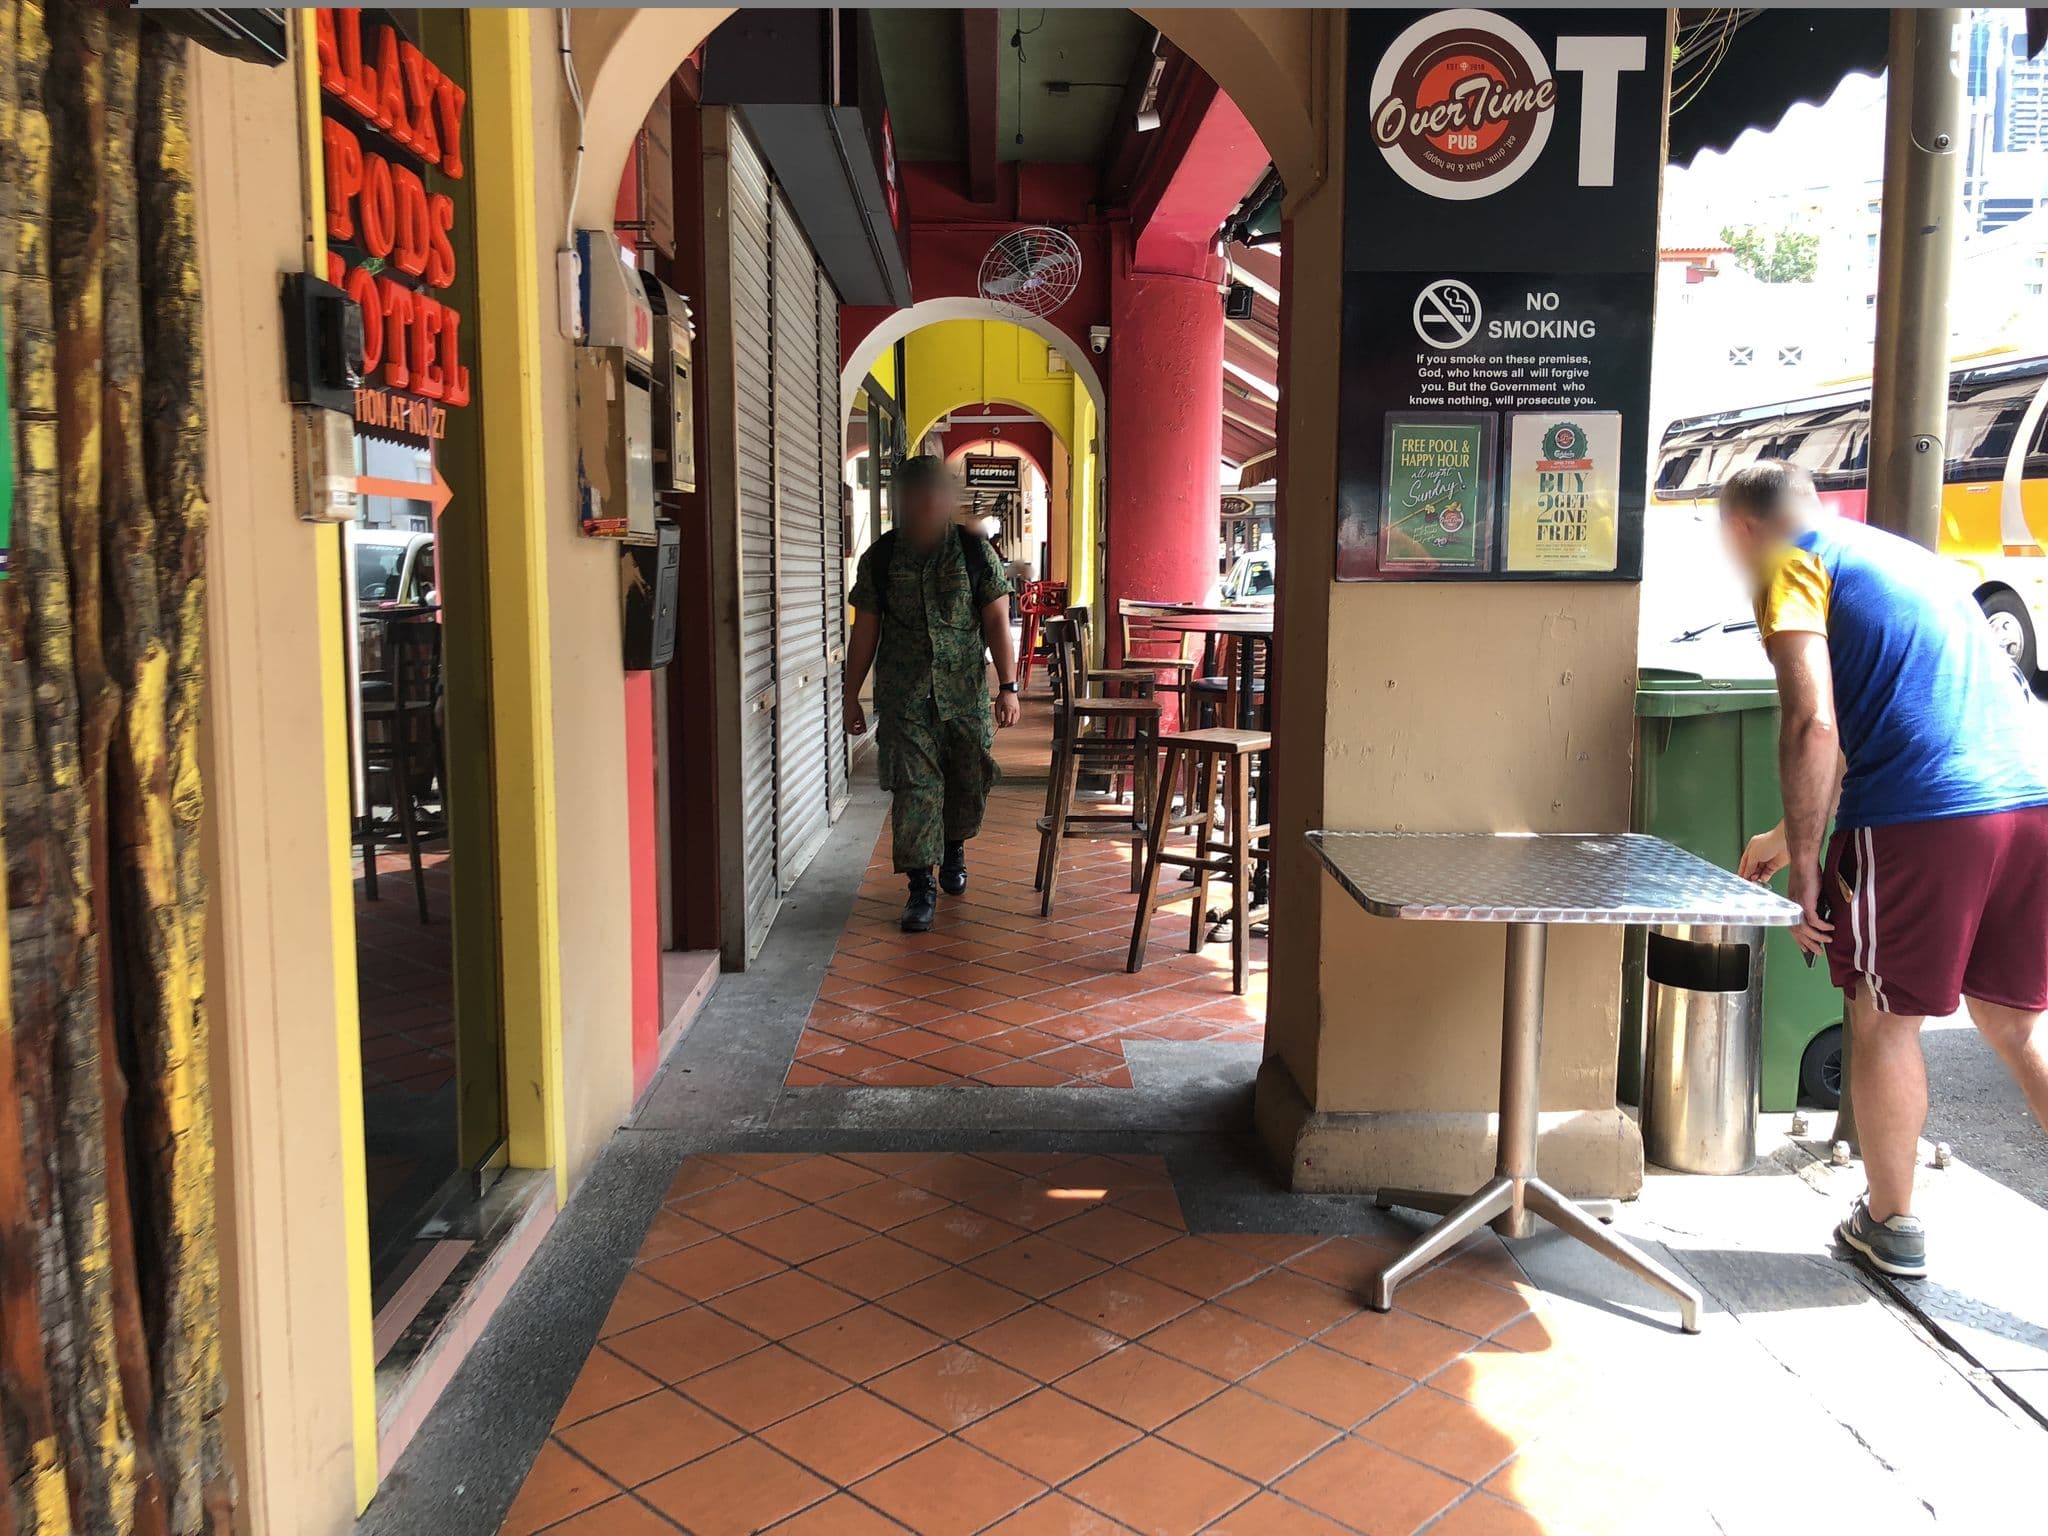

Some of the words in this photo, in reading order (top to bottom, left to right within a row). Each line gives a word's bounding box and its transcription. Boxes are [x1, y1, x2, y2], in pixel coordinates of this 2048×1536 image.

[1448, 134, 1478, 150] PUB
[1422, 150, 1446, 169] happy
[1466, 161, 1485, 171] relax
[1446, 163, 1456, 172] be
[1458, 164, 1465, 173] &
[323, 117, 456, 289] PODS
[1526, 292, 1560, 311] NO
[1488, 319, 1596, 339] SMOKING
[1416, 354, 1425, 364] If
[1426, 356, 1447, 366] you
[1449, 354, 1486, 364] smoke
[1488, 356, 1503, 364] on
[1506, 354, 1536, 364] these
[1538, 354, 1592, 366] premises,
[1418, 367, 1444, 379] God,
[1446, 368, 1470, 378] who
[1472, 368, 1509, 378] knows
[1511, 368, 1524, 378] all
[1530, 368, 1549, 378] will
[1551, 368, 1590, 380] forgive
[1421, 383, 1445, 393] you.
[1447, 381, 1467, 391] But
[1469, 382, 1487, 391] the
[1490, 381, 1557, 391] Government
[1562, 381, 1586, 391] who
[1409, 395, 1445, 405] knows
[1447, 395, 1493, 407] nothing,
[1495, 395, 1514, 405] will
[1516, 395, 1571, 407] prosecute
[1573, 397, 1597, 407] you.
[390, 395, 407, 431] AT
[432, 407, 446, 439] 27
[1401, 439, 1426, 453] FREE
[1428, 439, 1459, 453] POOL
[1461, 440, 1470, 453] &
[1401, 454, 1436, 467] HAPPY
[1437, 454, 1470, 468] HOUR
[969, 468, 1016, 477] RECEPTION
[1539, 472, 1589, 493] BUY
[1536, 494, 1553, 523] 2
[1554, 494, 1589, 509] GET
[1553, 509, 1588, 524] ONE
[1537, 525, 1588, 541] FREE
